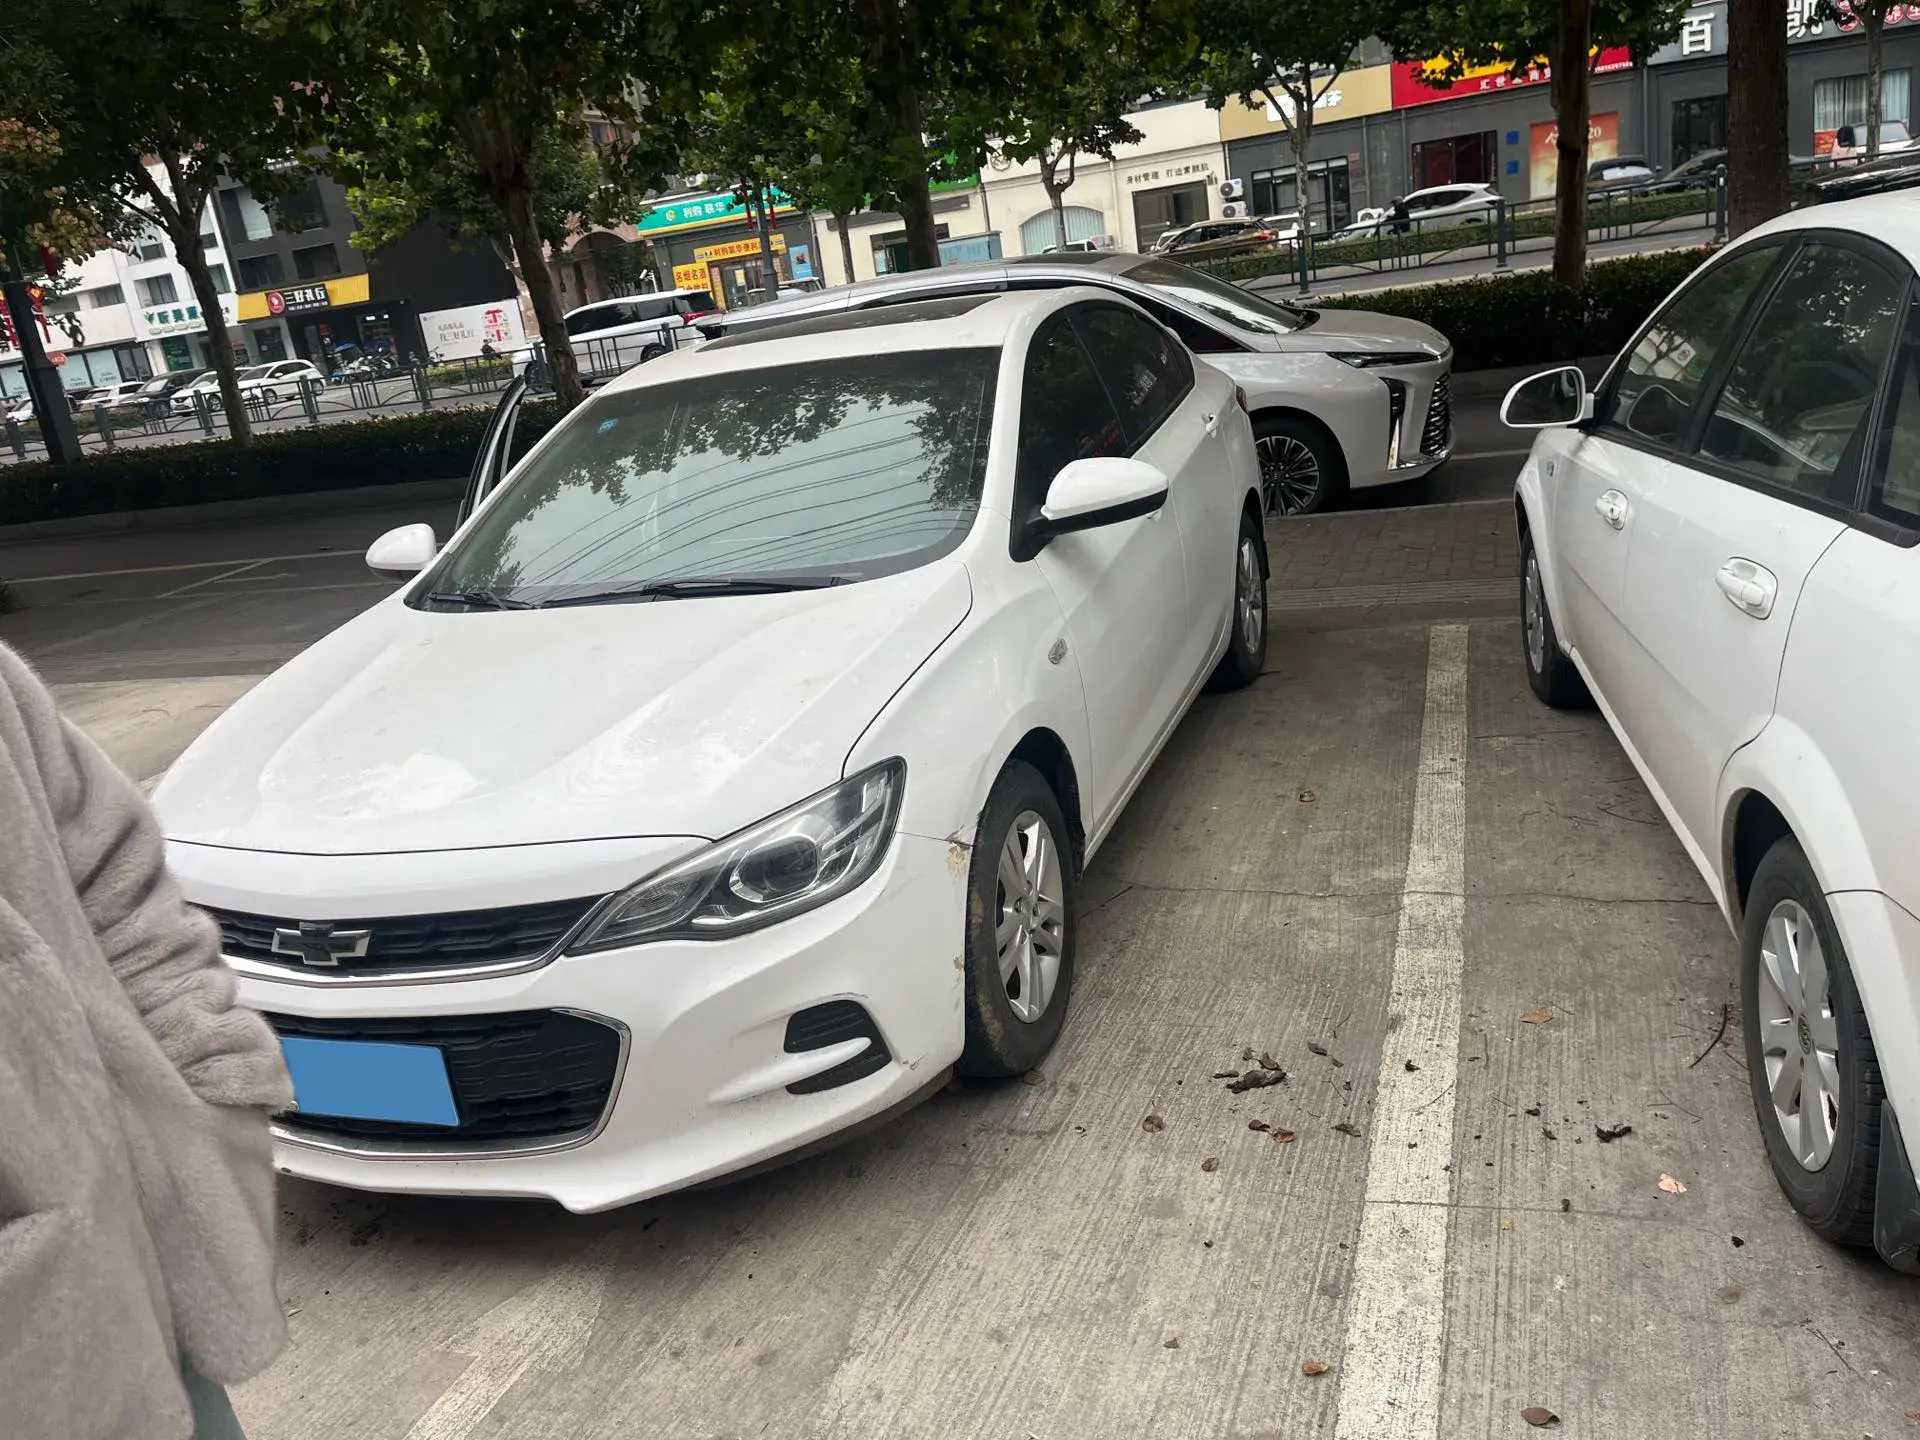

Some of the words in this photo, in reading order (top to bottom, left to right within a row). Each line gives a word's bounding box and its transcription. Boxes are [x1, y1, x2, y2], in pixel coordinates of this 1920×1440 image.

[1680, 13, 1715, 55] 百
[1126, 171, 1160, 184] 身材管理
[675, 268, 707, 283] 名烟名酒
